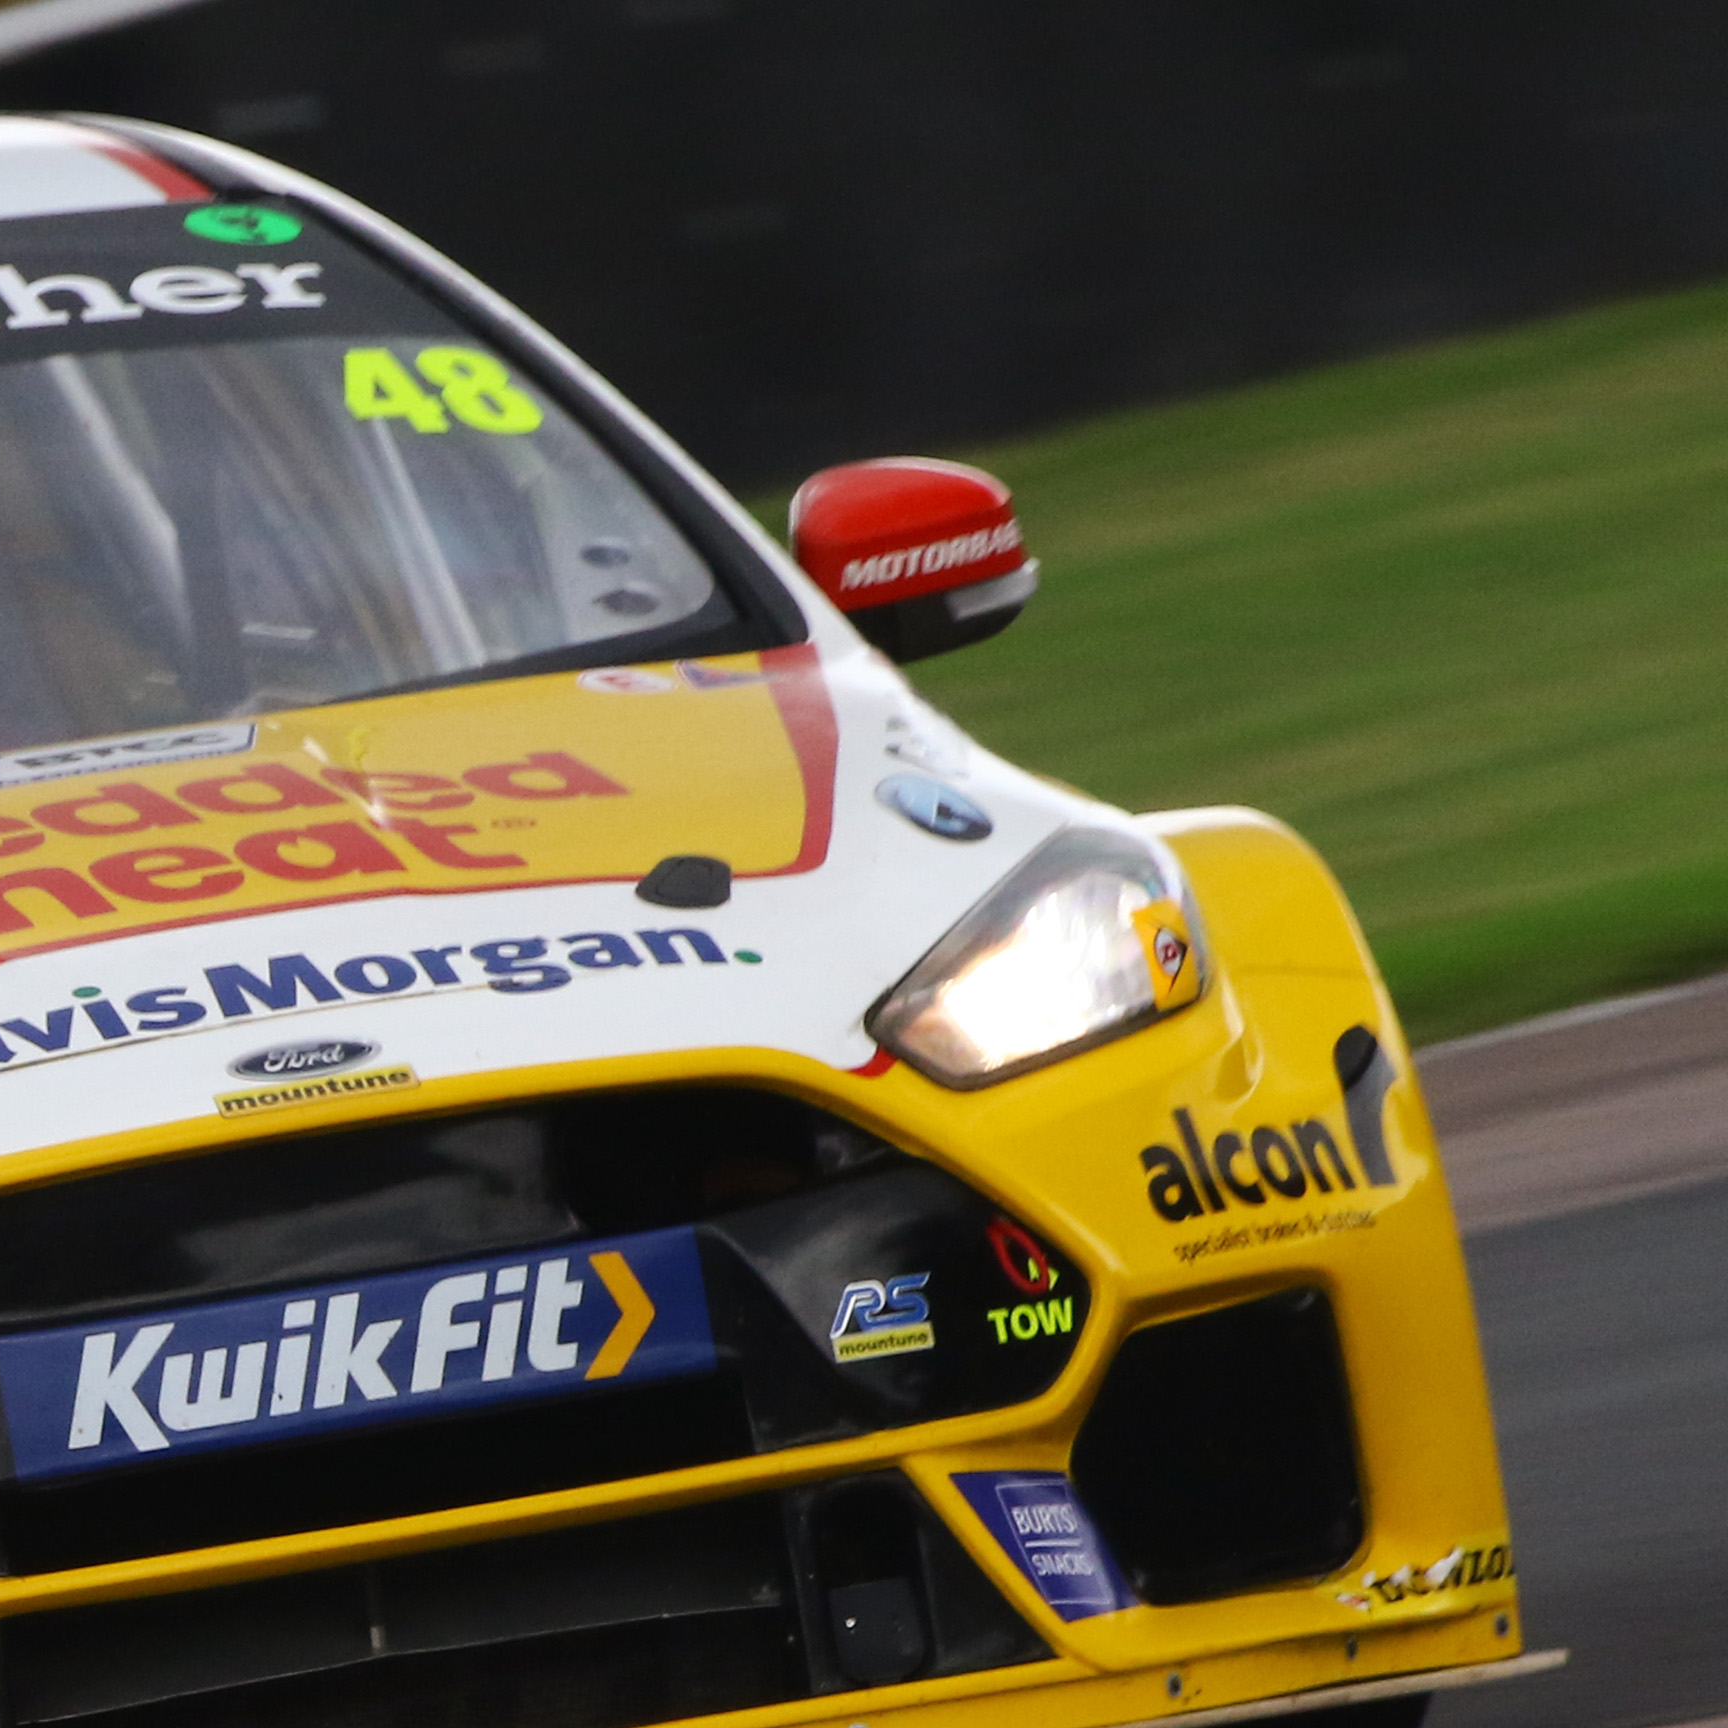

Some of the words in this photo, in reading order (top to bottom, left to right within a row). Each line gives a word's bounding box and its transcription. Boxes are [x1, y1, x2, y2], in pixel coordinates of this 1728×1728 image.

[343, 346, 543, 435] 48
[840, 517, 1021, 591] MOTORBAS
[263, 1043, 347, 1073] Ford
[222, 1070, 410, 1112] mountune
[1139, 1106, 1357, 1225] alcon
[830, 1271, 931, 1340] RS
[987, 1296, 1073, 1344] TOW
[838, 1330, 929, 1356] mountune
[1011, 1504, 1078, 1537] BURTS
[1031, 1551, 1095, 1578] SNACKS
